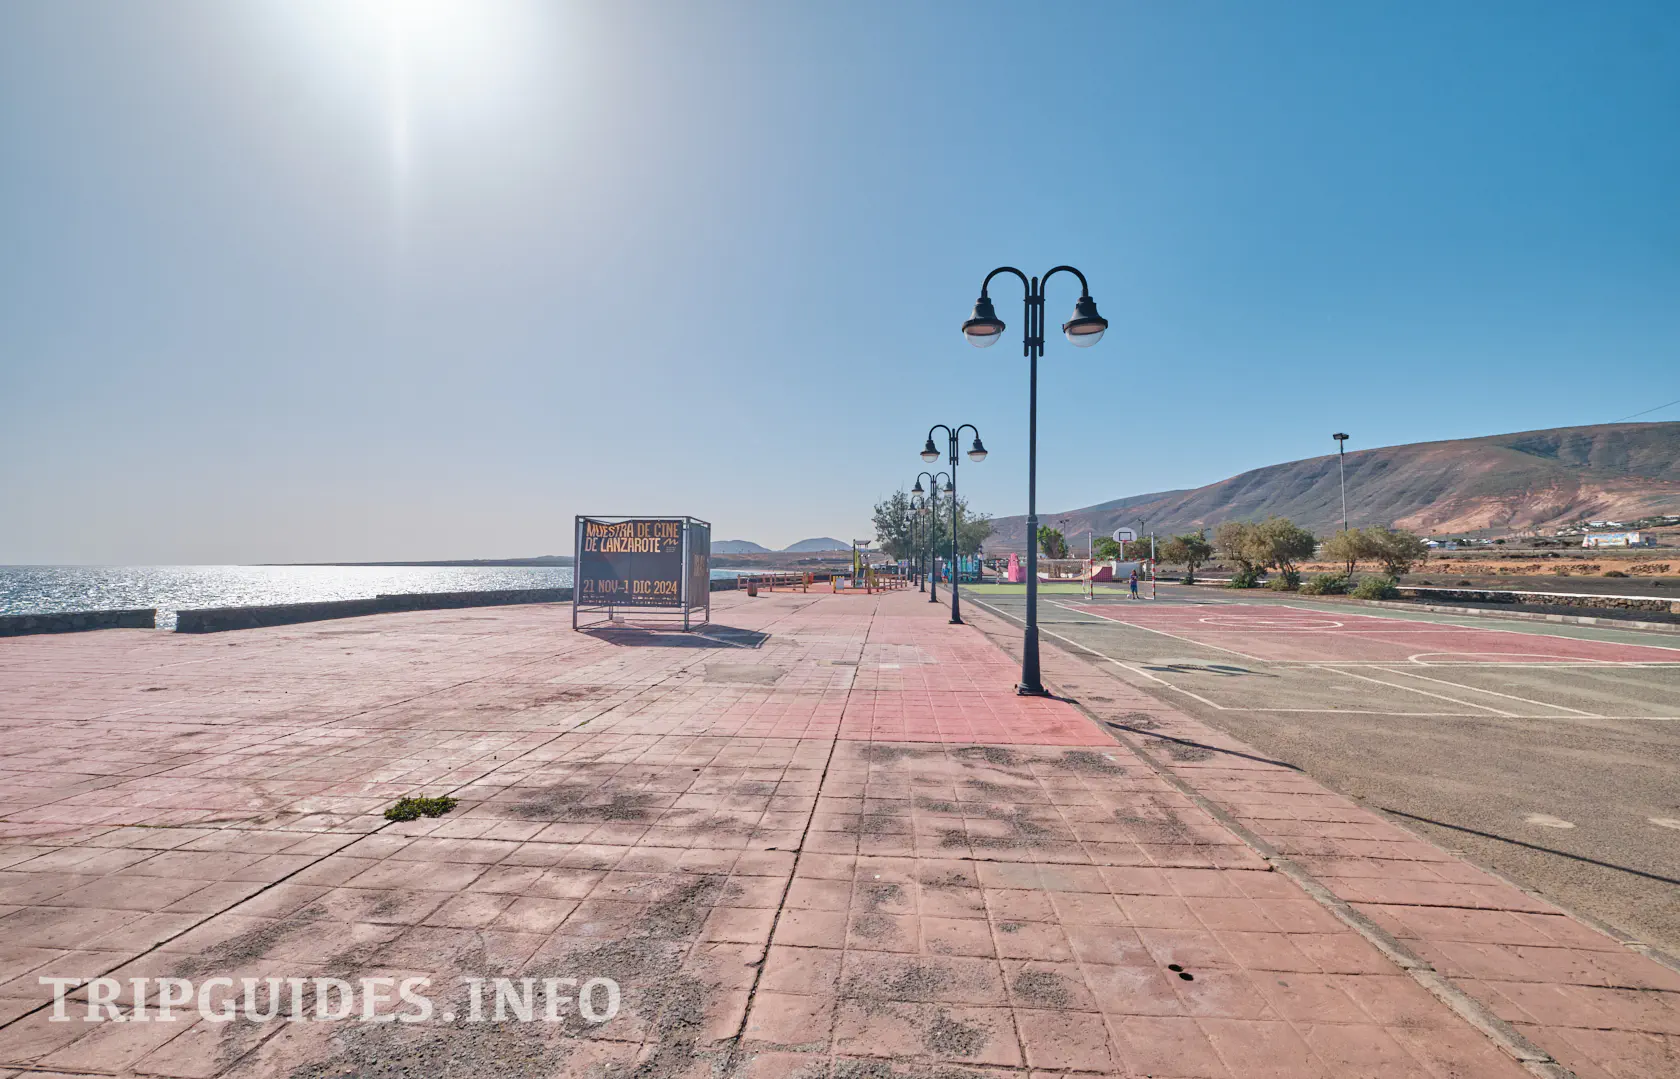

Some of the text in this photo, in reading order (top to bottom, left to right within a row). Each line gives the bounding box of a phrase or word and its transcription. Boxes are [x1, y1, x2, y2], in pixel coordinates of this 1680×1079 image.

[586, 522, 679, 538] MUESTRA DE CINE
[585, 537, 598, 552] DE
[600, 537, 661, 553] LANZAROTE
[583, 579, 595, 593] 21
[633, 580, 651, 594] DIC
[653, 580, 678, 595] 2024
